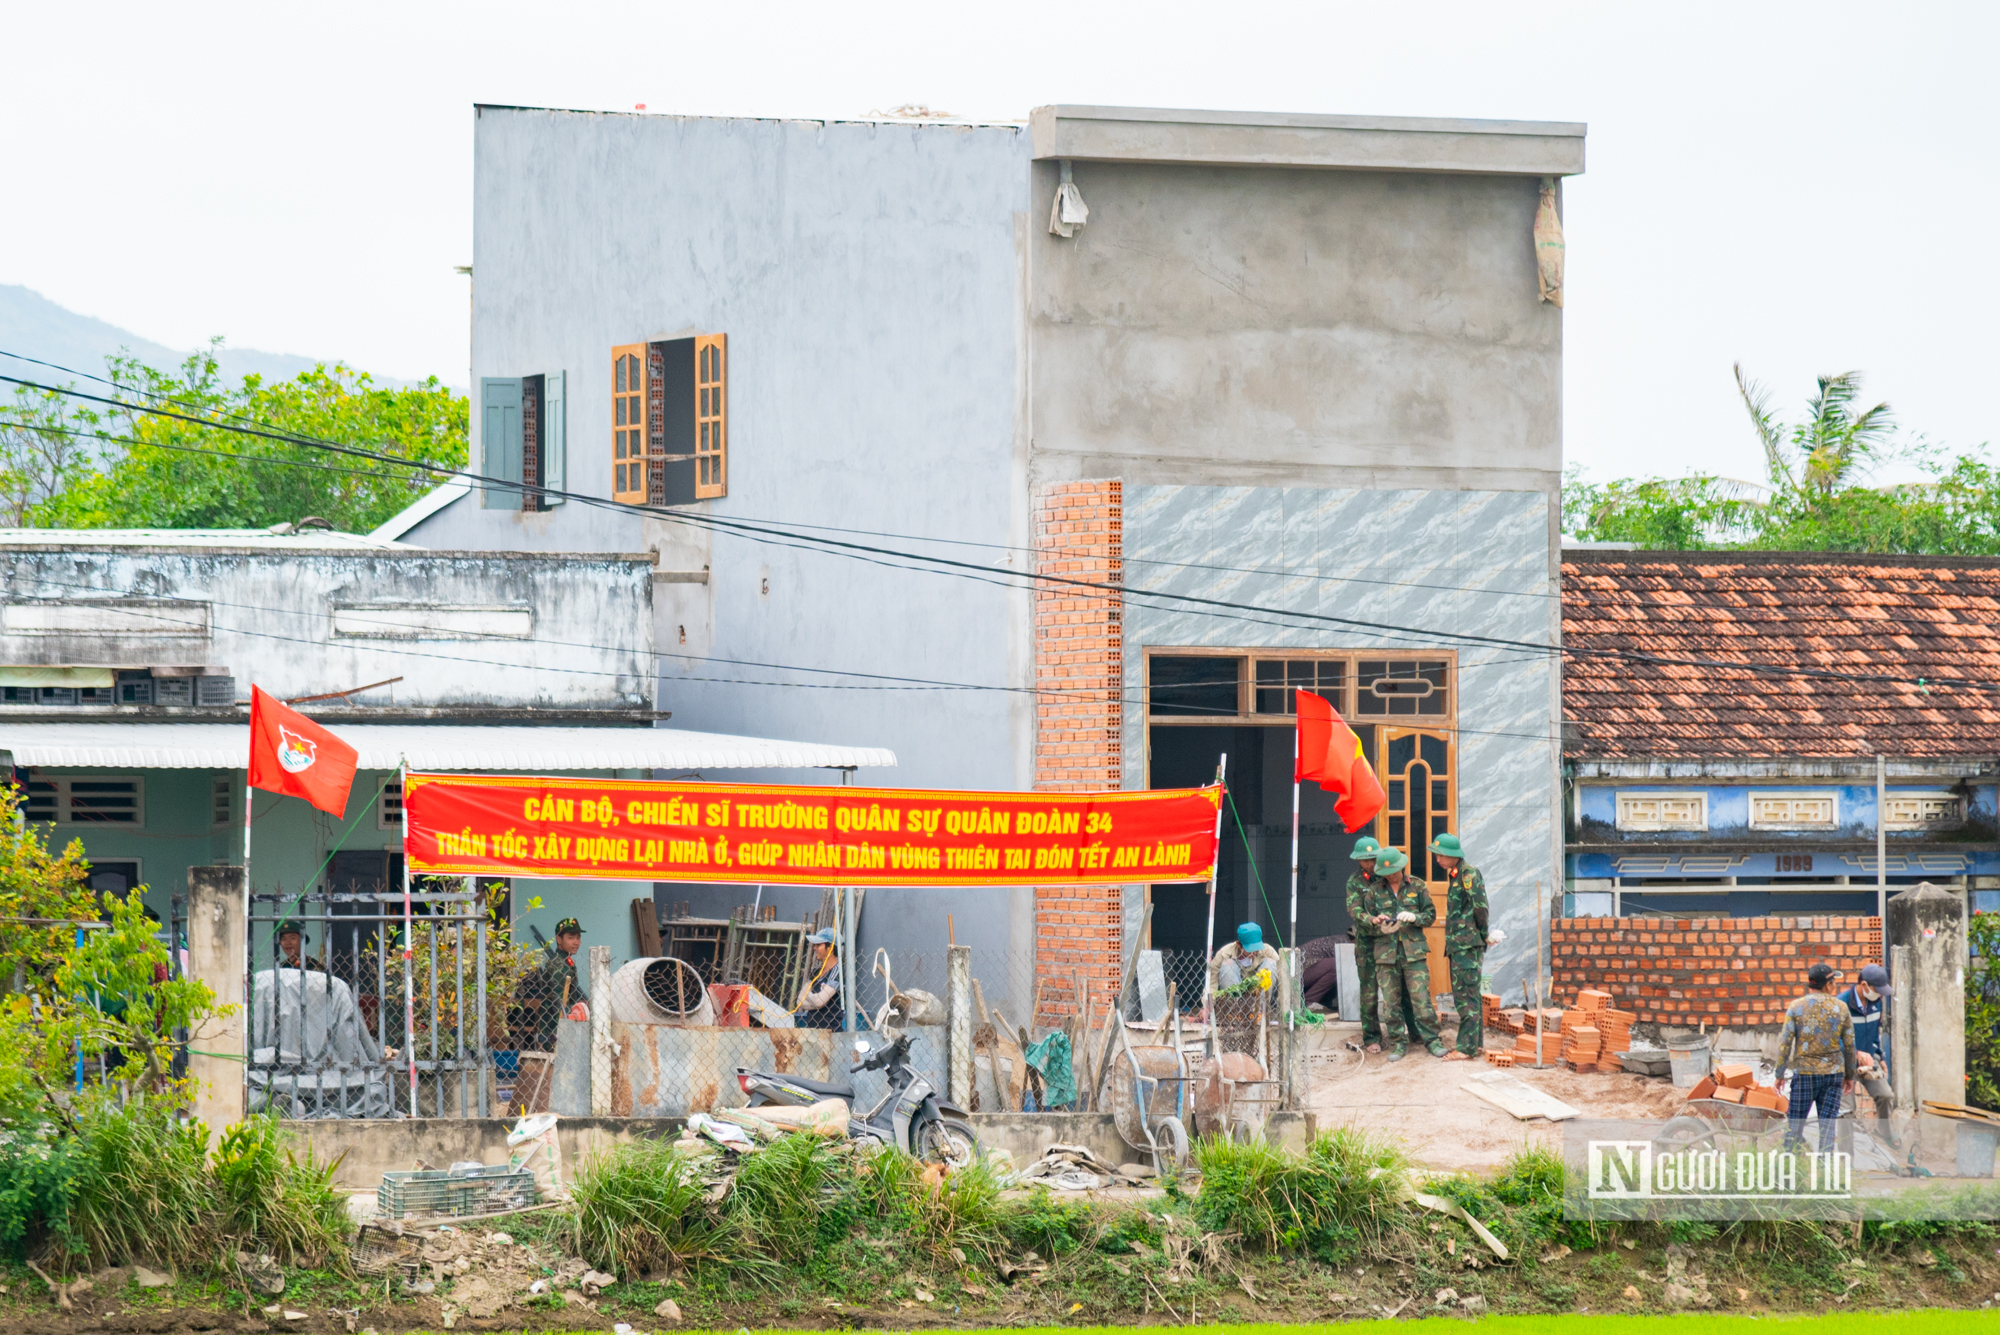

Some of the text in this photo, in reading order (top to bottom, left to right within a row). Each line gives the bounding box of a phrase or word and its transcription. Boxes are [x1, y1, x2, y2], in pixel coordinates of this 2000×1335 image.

[525, 794, 1112, 837] CÁN BỘ, CHIẾN SĨ TRƯỜNG QUÂN SỰ QUÂN ĐOÀN 34
[435, 826, 1190, 869] THẦN TỐC XÂY DỰNG LẠI NHÀ Ở, GIÚP NHÂN DÂN VÙNG THIÊN TAI ĐÓN TẾT AN LÀNH
[1775, 855, 1812, 872] 1989
